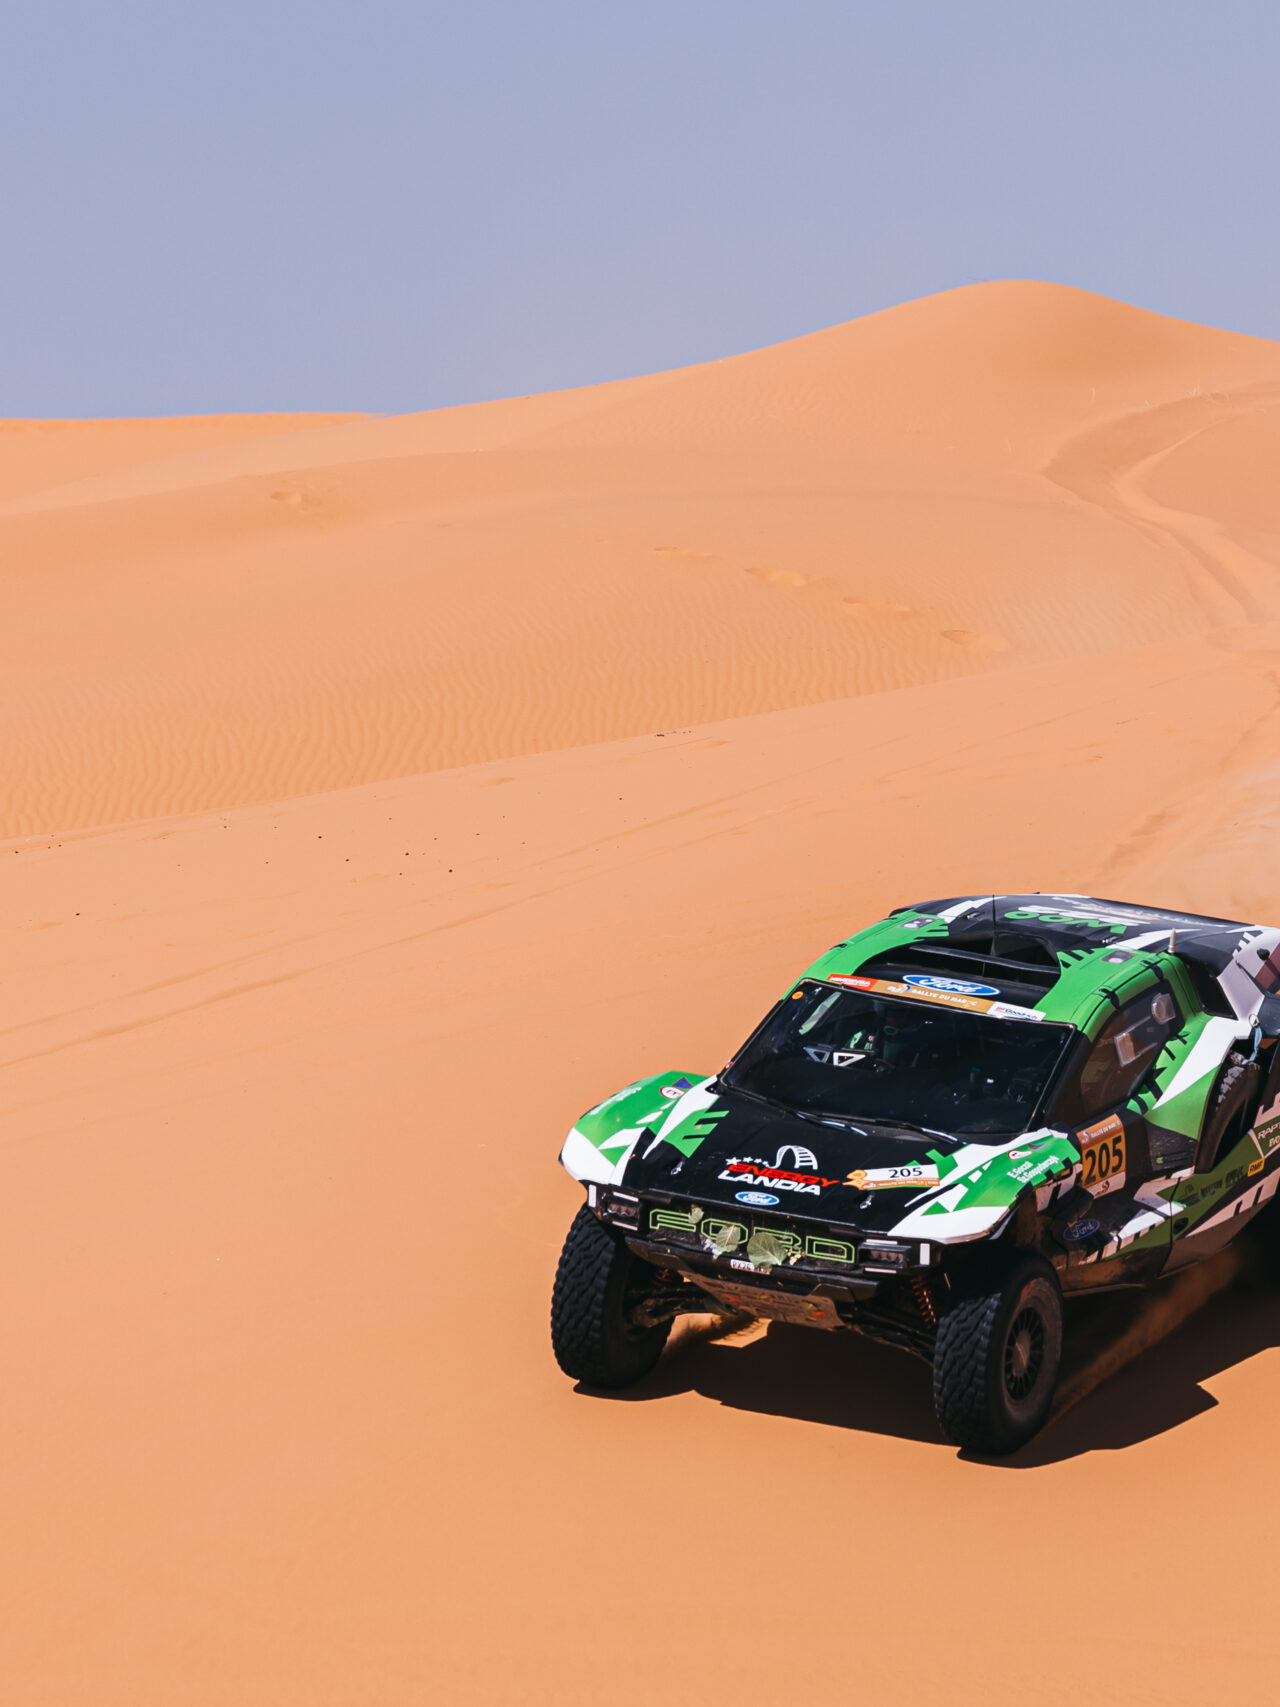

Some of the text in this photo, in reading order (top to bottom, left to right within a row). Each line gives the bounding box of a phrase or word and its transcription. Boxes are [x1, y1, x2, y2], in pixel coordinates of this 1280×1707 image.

[912, 988, 938, 998] RALLYE
[918, 976, 982, 993] Ford
[1084, 1135, 1123, 1186] 205
[717, 1169, 821, 1196] LANDIA
[727, 1162, 840, 1188] ENERGY
[888, 1167, 923, 1179] 205
